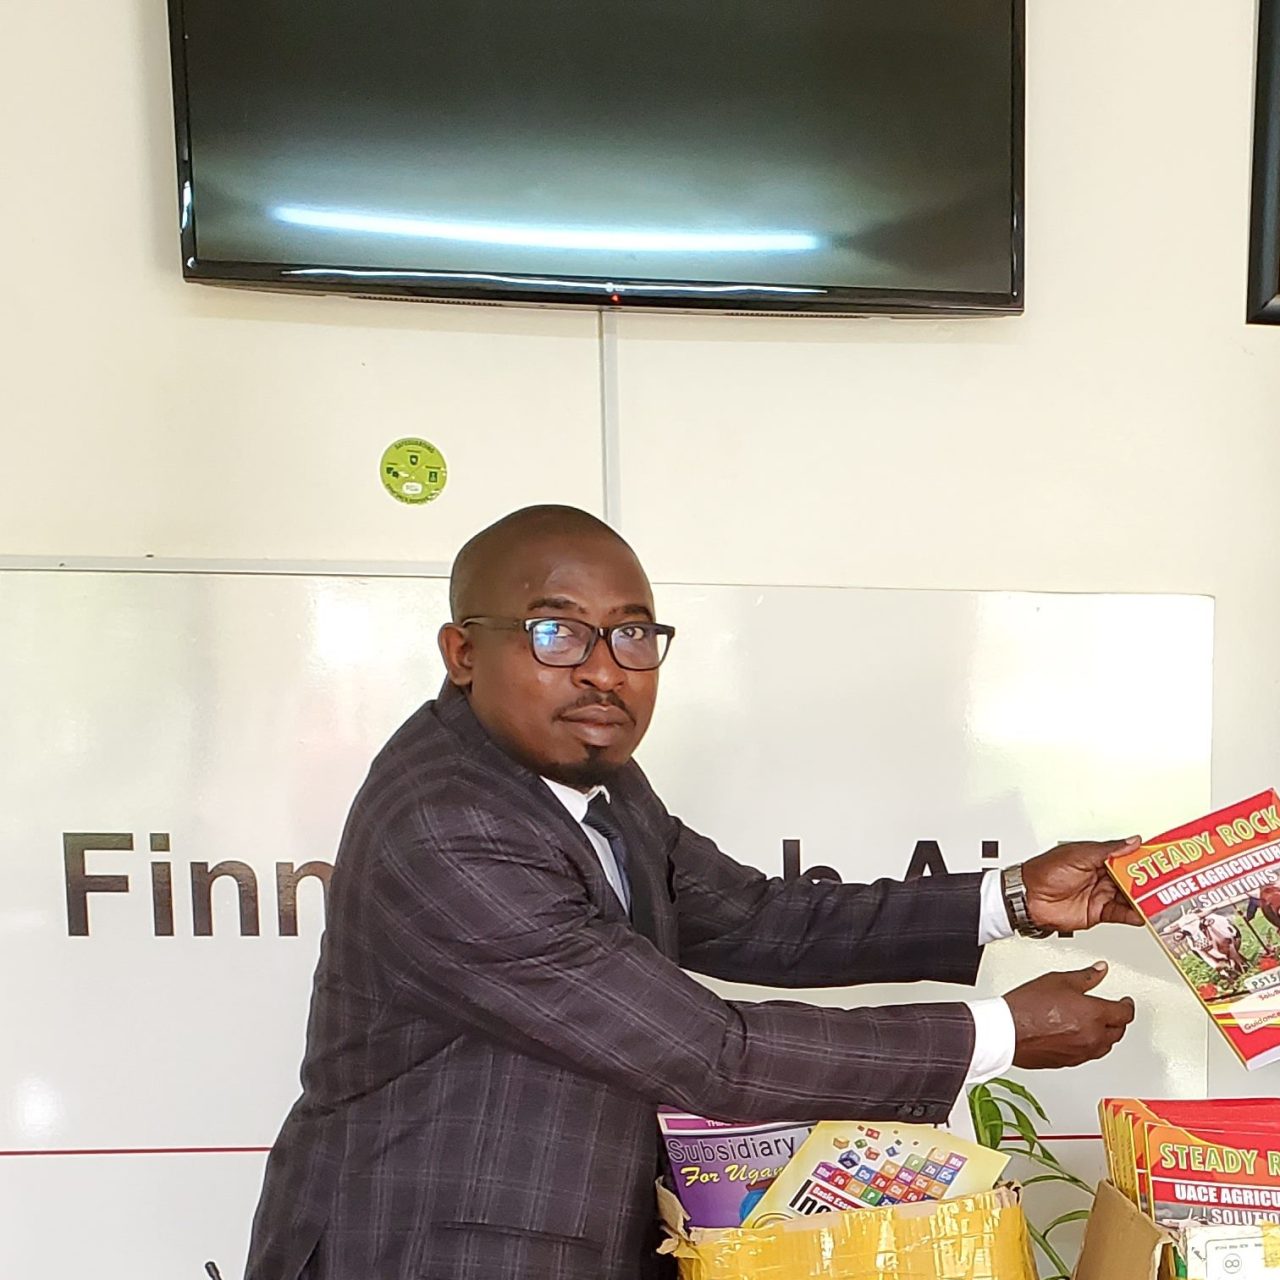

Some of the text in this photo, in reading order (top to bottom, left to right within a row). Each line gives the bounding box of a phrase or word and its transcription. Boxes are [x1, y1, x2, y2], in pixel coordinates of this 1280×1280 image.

[1127, 832, 1216, 887] STEADY
[63, 832, 337, 937] Finn
[1157, 873, 1200, 905] UACE
[1198, 869, 1278, 908] SOLUTIONS
[667, 1135, 795, 1163] Subsidiary
[1159, 1142, 1258, 1175] STEADY
[680, 1166, 720, 1187] For
[1174, 1184, 1217, 1204] UACE
